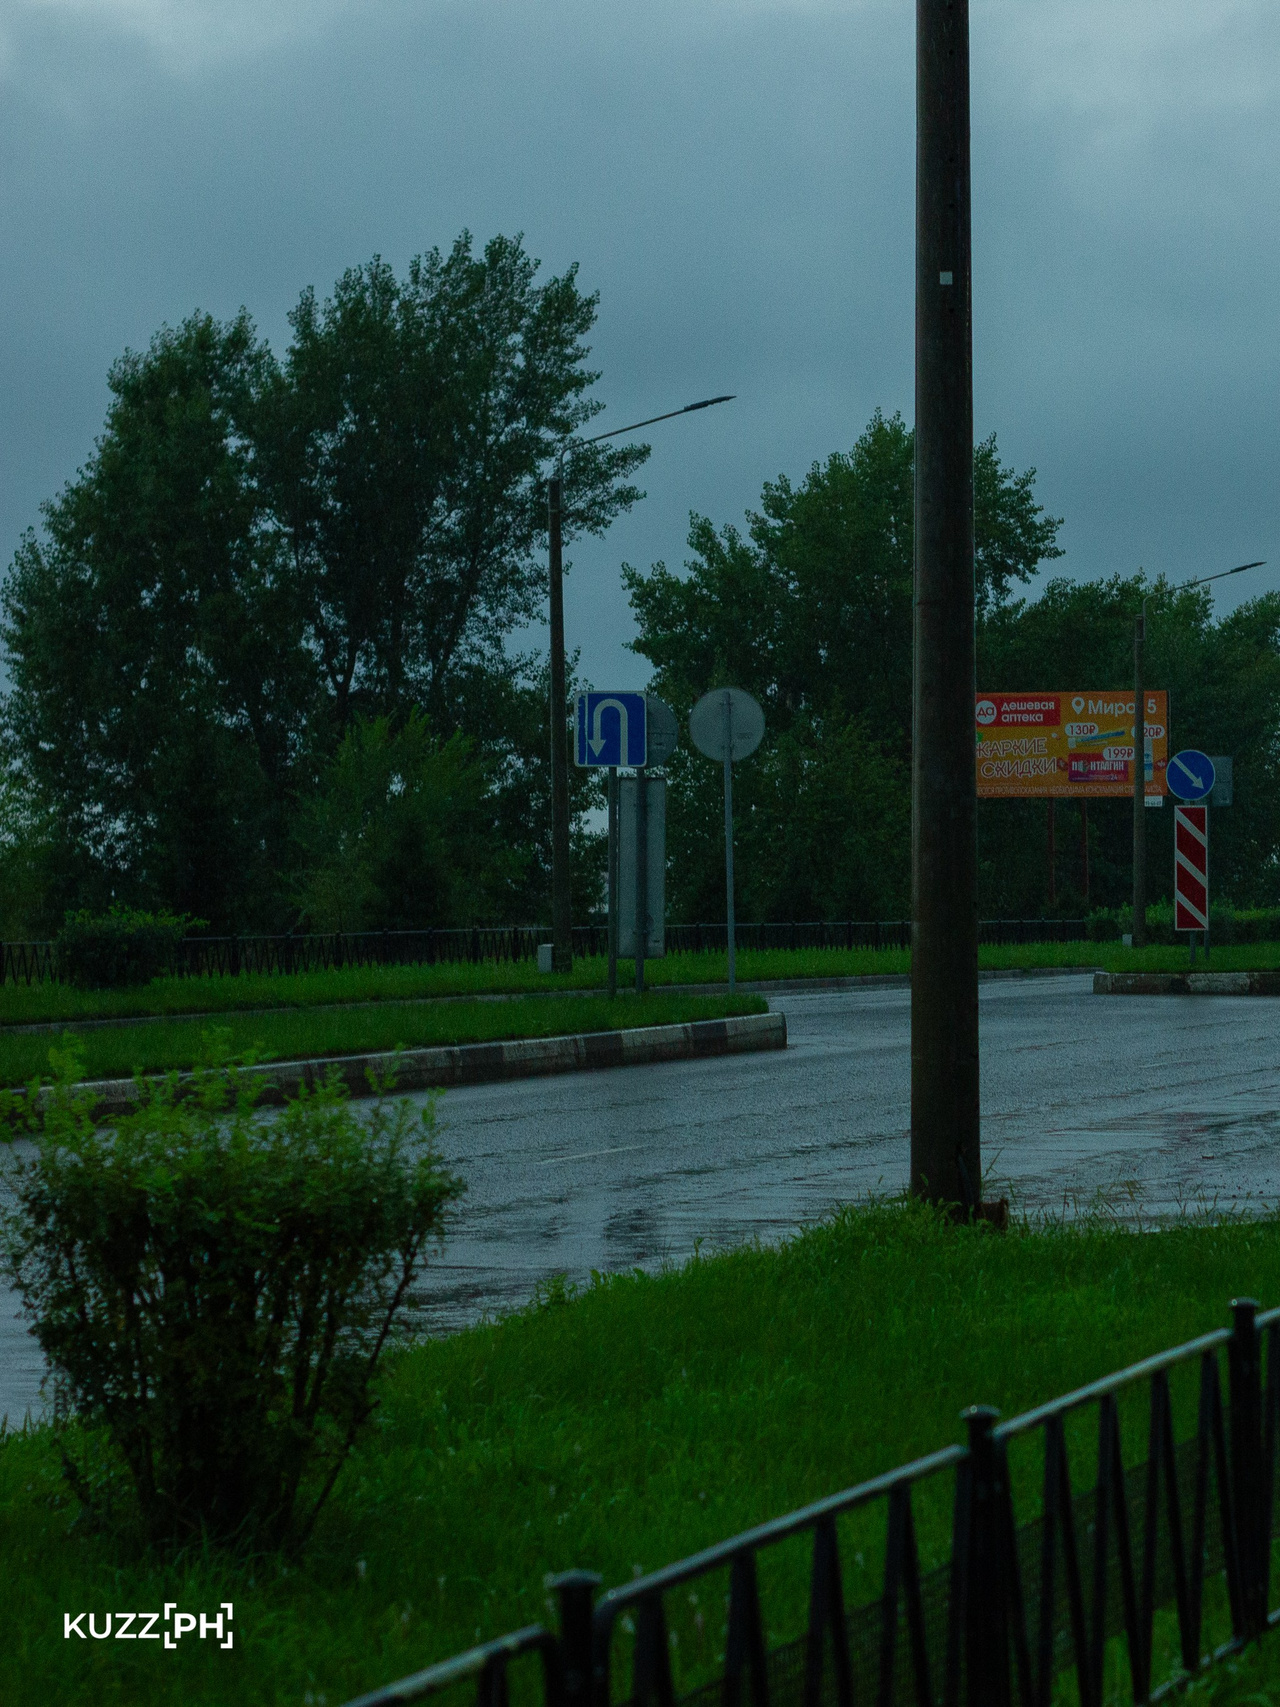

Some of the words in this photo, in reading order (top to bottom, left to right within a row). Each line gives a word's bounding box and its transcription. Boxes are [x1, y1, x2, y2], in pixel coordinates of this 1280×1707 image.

[1001, 701, 1056, 712] дешевая
[1147, 698, 1157, 714] 5
[1001, 713, 1044, 723] аптека
[1107, 747, 1134, 758] 199₽
[980, 757, 1057, 778] СКИДКИ
